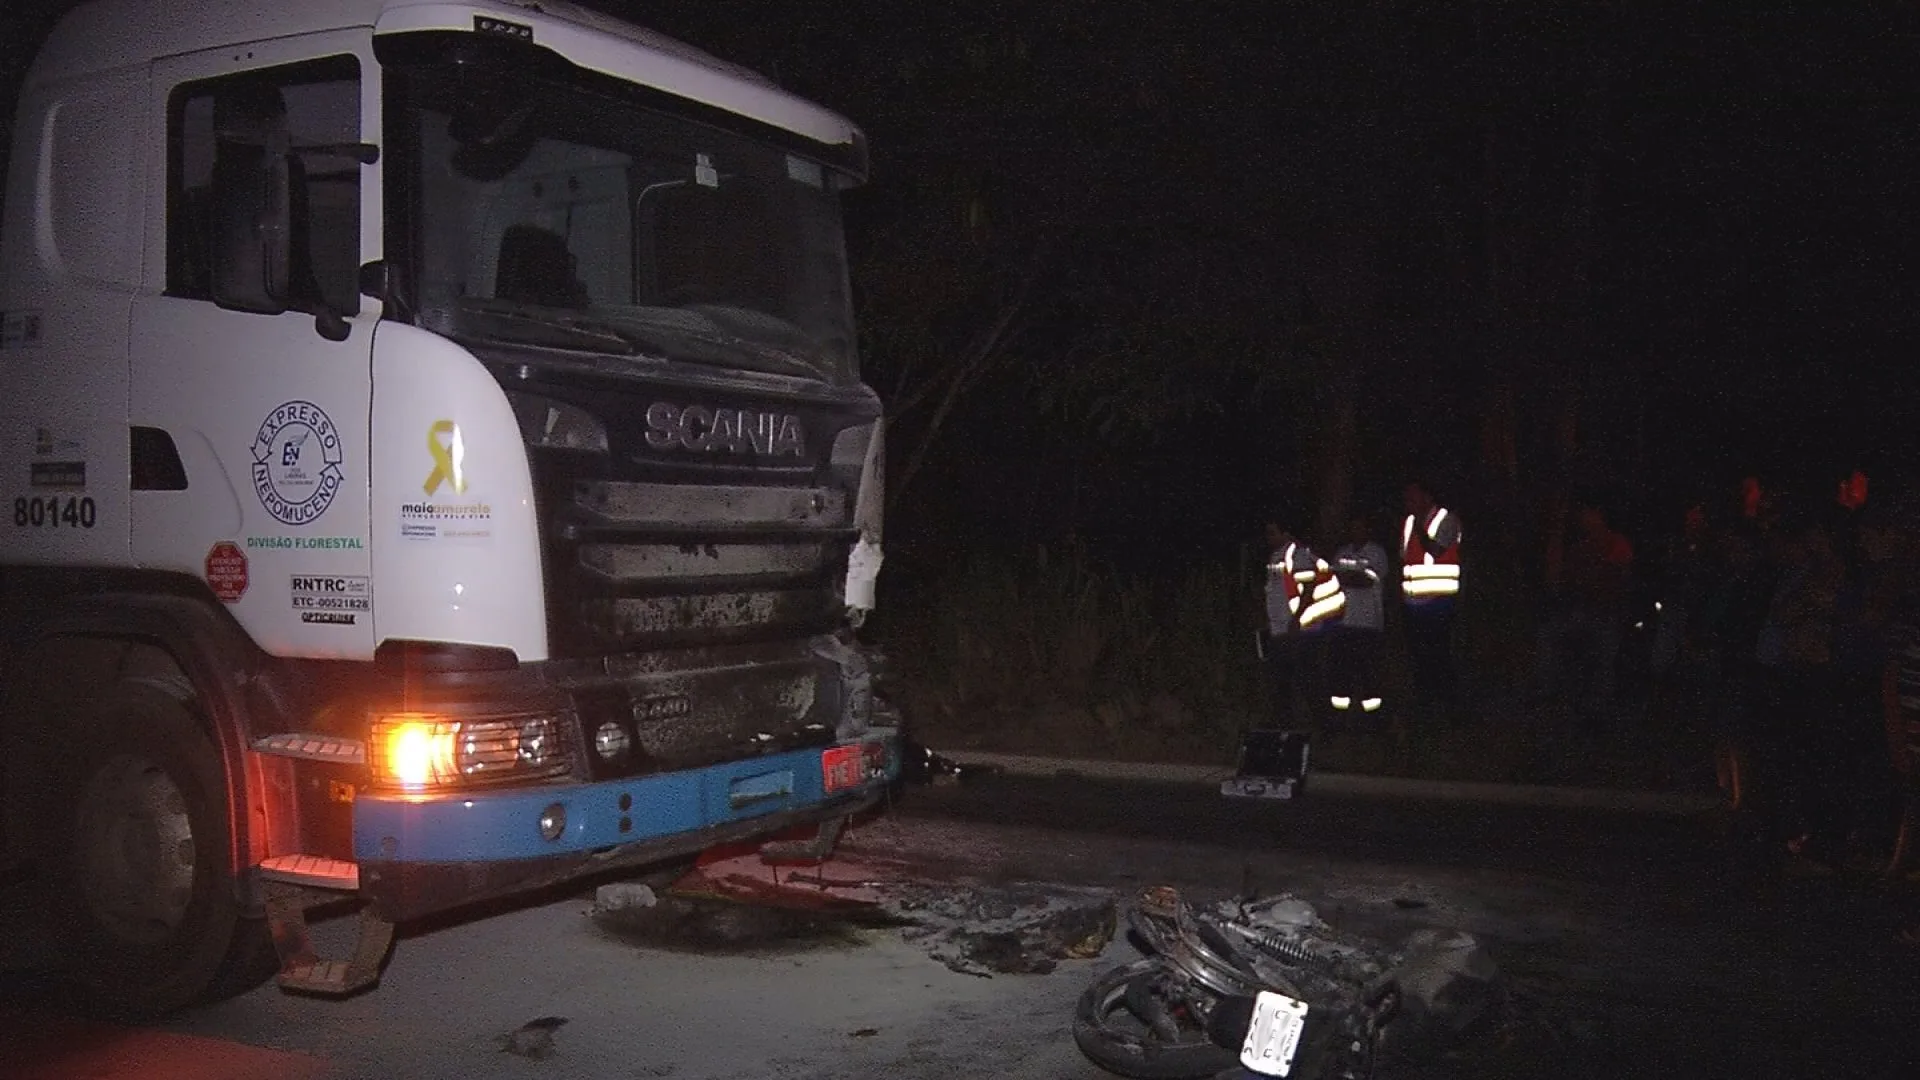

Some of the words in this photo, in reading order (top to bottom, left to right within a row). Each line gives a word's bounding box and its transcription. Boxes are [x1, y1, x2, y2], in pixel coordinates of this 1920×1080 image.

[259, 405, 336, 450] EXPRESSO
[644, 401, 805, 456] SCANIA
[14, 496, 97, 528] 80140
[255, 474, 336, 521] NEPOMUCENO
[247, 536, 292, 549] DIVISÃO
[295, 537, 364, 550] FLORESTAL
[292, 578, 346, 592] RNTRC
